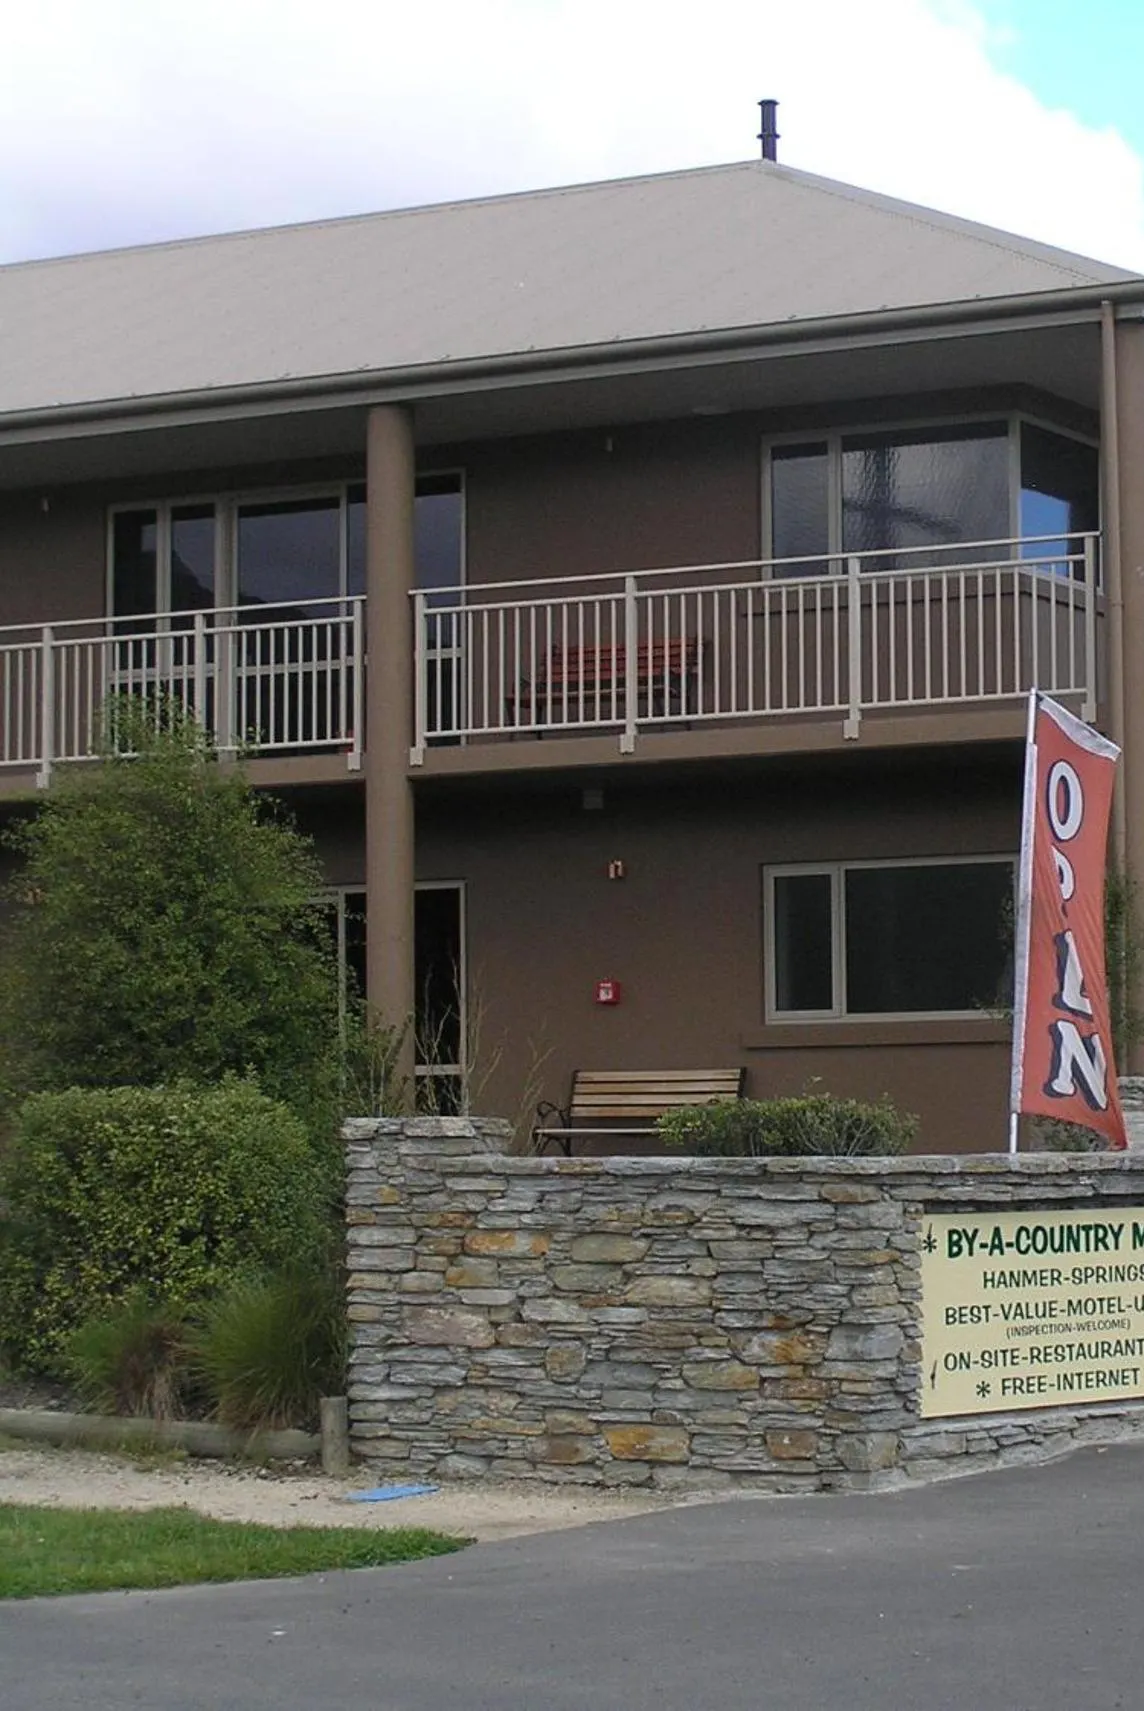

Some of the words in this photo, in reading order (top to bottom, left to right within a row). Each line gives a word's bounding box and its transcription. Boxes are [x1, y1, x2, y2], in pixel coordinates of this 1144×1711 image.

[947, 1223, 1124, 1258] BY-A-COUNTRY
[1006, 1319, 1131, 1339] (INSPECTION-WELCOME)
[1001, 1367, 1140, 1396] FREE-INTERNET
